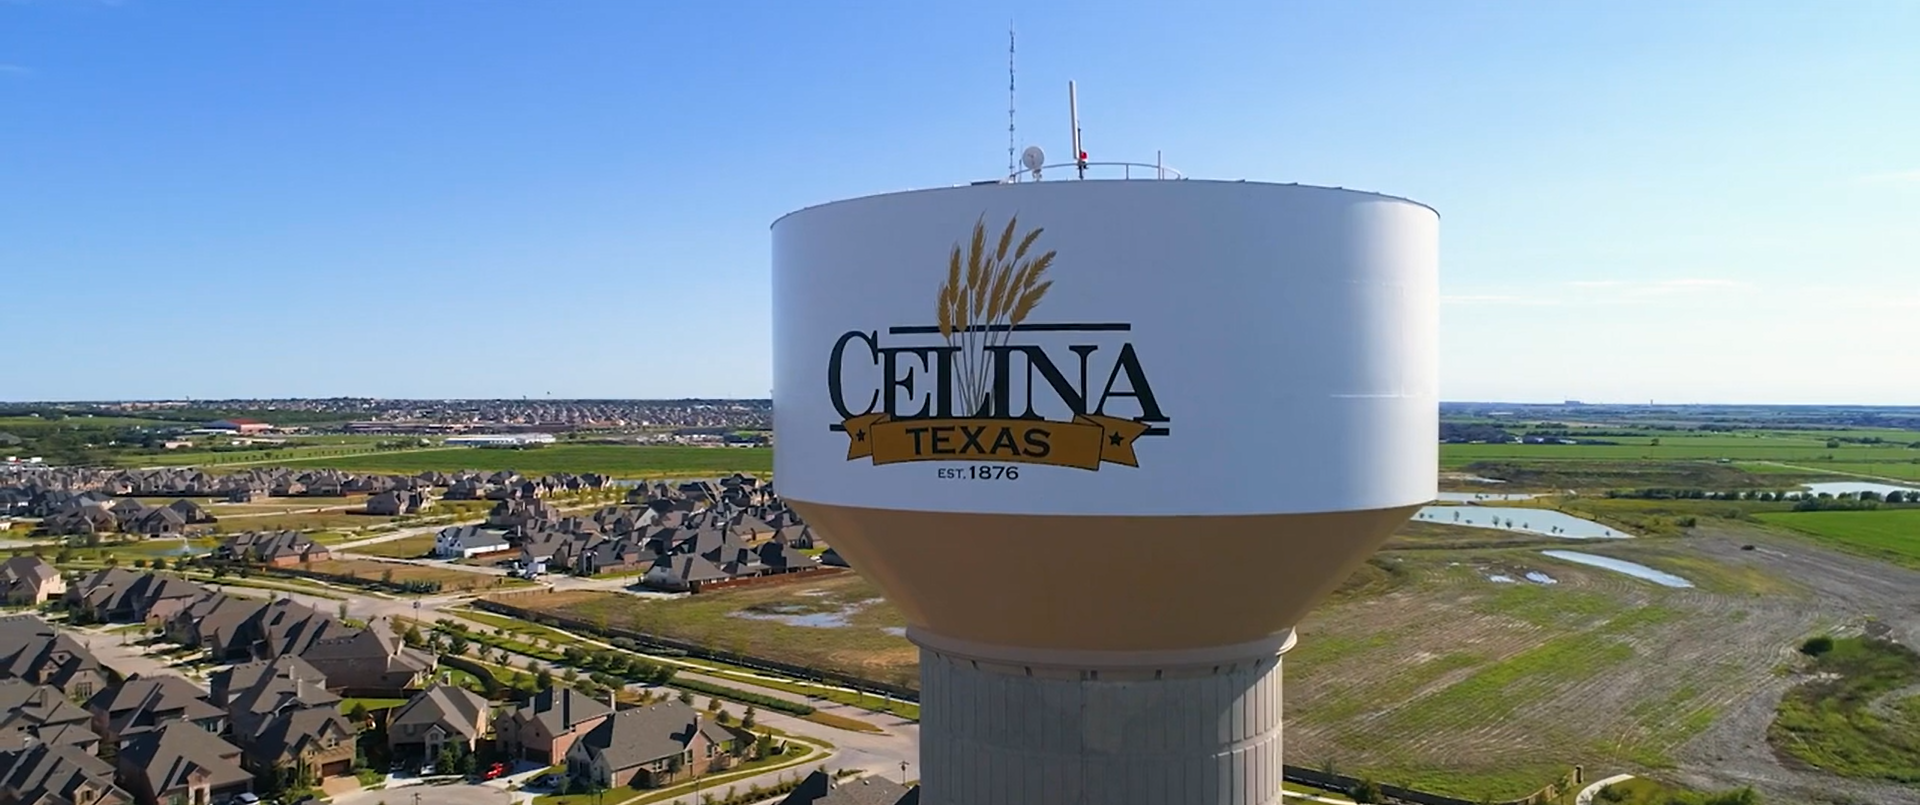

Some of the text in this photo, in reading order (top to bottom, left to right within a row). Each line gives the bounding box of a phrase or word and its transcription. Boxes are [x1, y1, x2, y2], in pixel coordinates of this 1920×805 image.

[828, 330, 1170, 422] CELINA
[905, 426, 1051, 459] TEXAS
[938, 465, 1019, 480] EST. 1876
